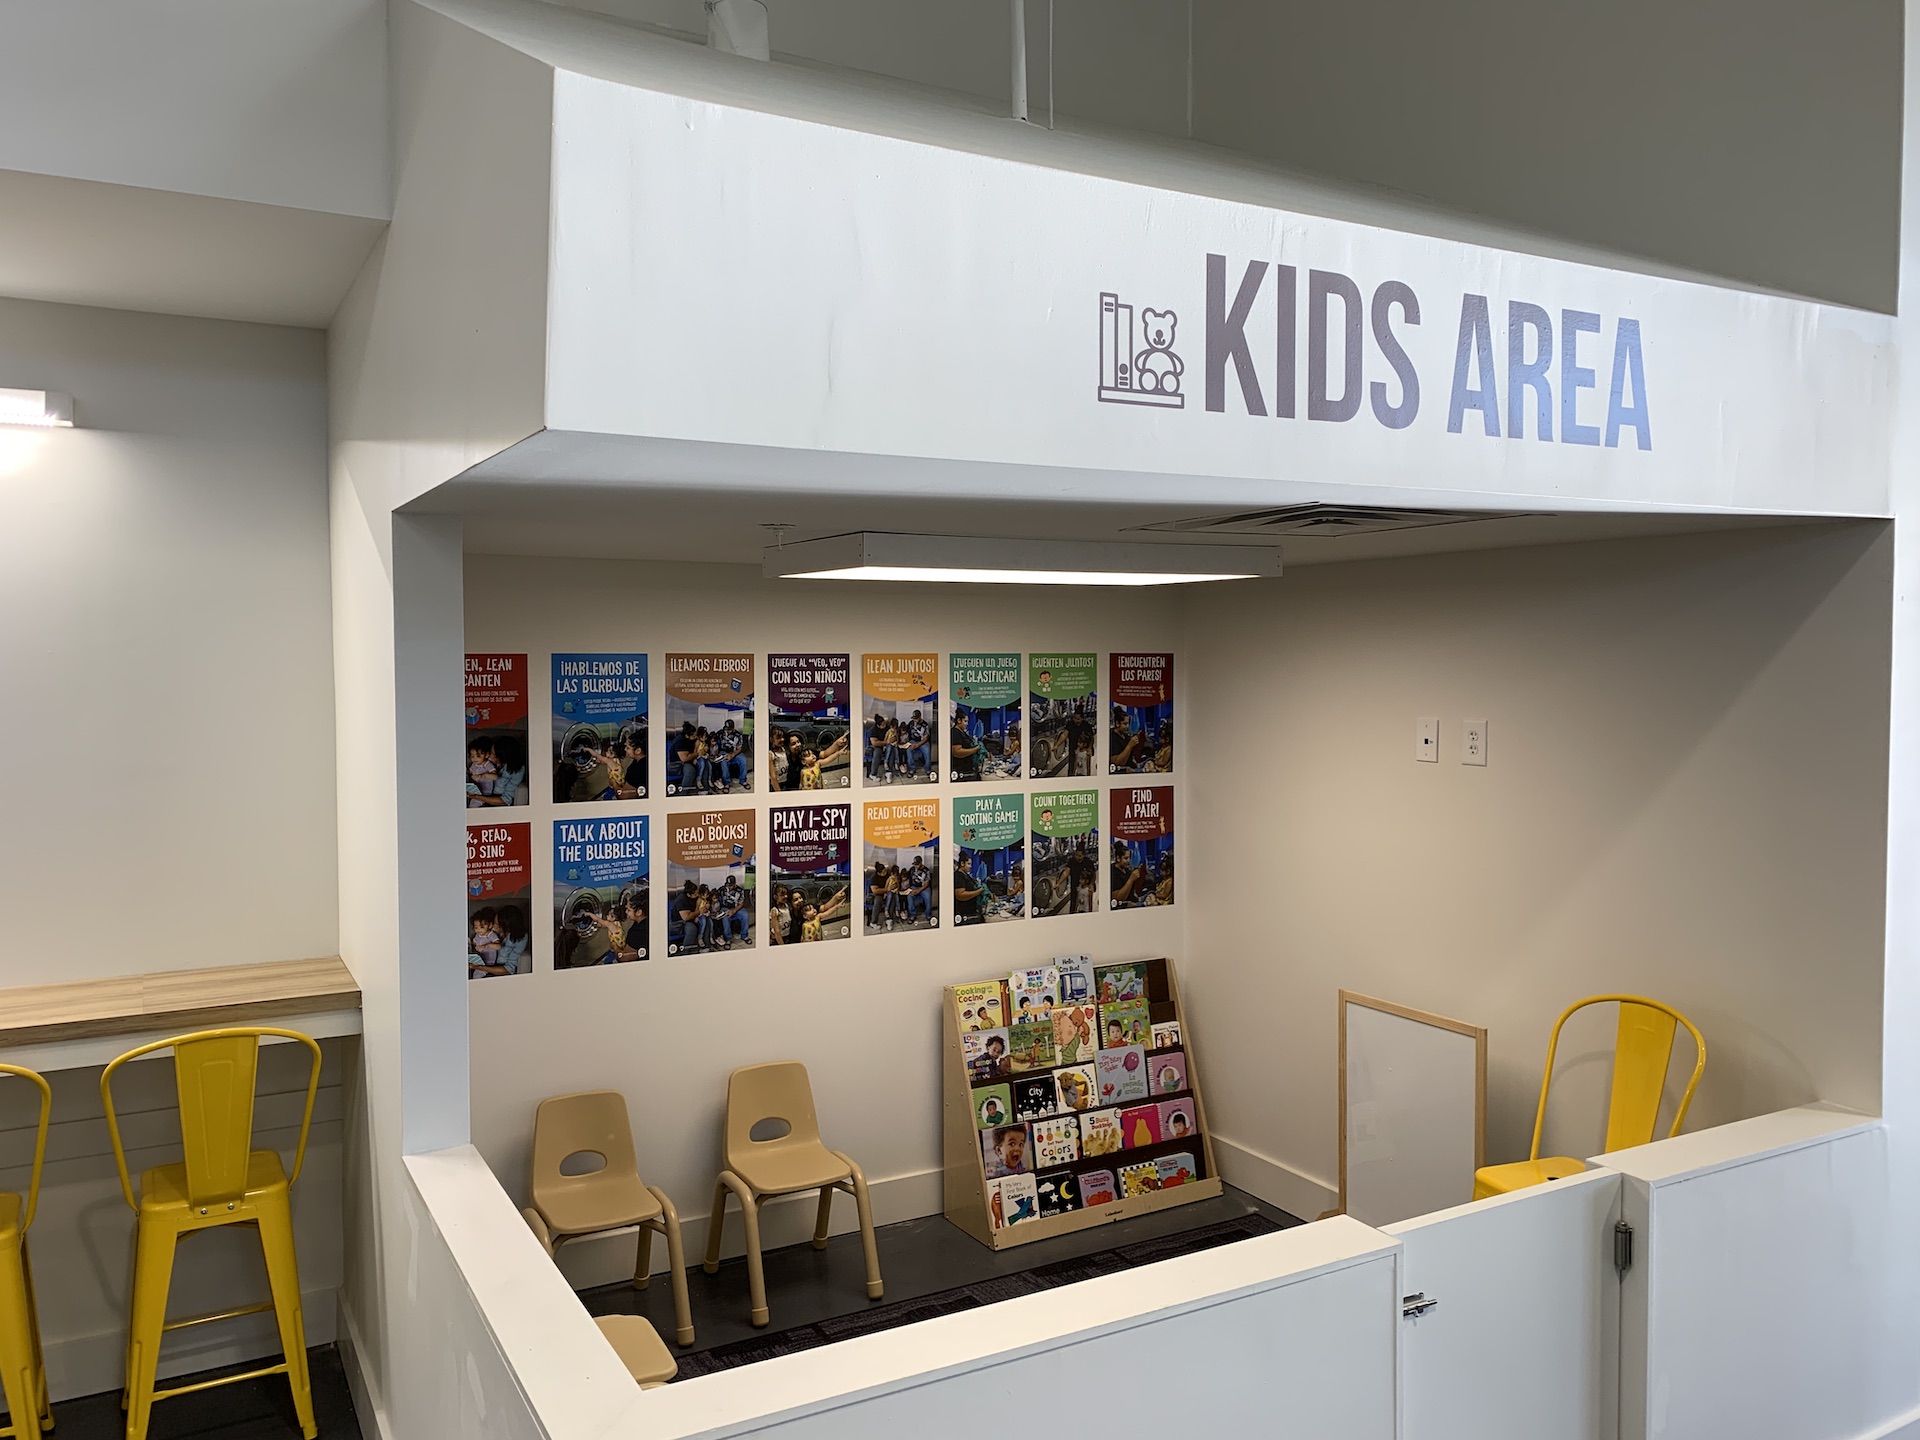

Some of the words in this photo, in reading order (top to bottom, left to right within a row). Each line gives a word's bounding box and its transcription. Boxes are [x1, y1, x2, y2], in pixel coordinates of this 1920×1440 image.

[1205, 252, 1421, 430] KIDS
[1446, 292, 1653, 452] AREA
[486, 658, 512, 671] LEAN
[561, 661, 622, 676] ¡HABLEMOS
[625, 661, 640, 676] DE
[713, 658, 750, 672] LIBROS!
[799, 658, 807, 667] AL
[896, 658, 935, 674] JUNTOS!
[997, 657, 1018, 668] JUEGO
[771, 670, 791, 684] CON
[793, 670, 812, 683] SUS
[814, 668, 846, 683] NIÑOS!
[953, 670, 965, 683] DE
[966, 669, 1017, 683] CLASIFICAR!
[1121, 669, 1135, 681] LOS
[1136, 669, 1162, 681] PARES!
[556, 678, 578, 694] LAS
[582, 678, 644, 693] BURBUJAS!
[1033, 795, 1057, 808] COUNT
[1058, 793, 1096, 806] TOGETHER!
[1132, 789, 1152, 803] FIND
[867, 807, 889, 820] READ
[892, 803, 936, 818] TOGETHER!
[975, 799, 994, 811] PLAY
[995, 798, 1002, 810] A
[1125, 804, 1131, 819] A
[1134, 802, 1160, 818] PAIR!
[701, 813, 723, 825] LET'S
[773, 810, 805, 830] PLAY
[809, 808, 847, 828] I-SPY
[959, 812, 993, 826] SORTING
[995, 810, 1019, 823] GAME!
[481, 828, 512, 843] READ,
[560, 824, 595, 843] TALK
[599, 820, 643, 841] ABOUT
[676, 826, 705, 843] READ
[708, 822, 748, 841] BOOKS!
[774, 831, 796, 843] WITH
[798, 829, 819, 842] YOUR
[821, 827, 848, 840] CHILD!
[479, 844, 505, 859] SING
[558, 845, 582, 862] THE
[586, 840, 645, 861] BUBBLES!
[955, 986, 986, 996] Cooking
[1028, 1088, 1044, 1096] City
[1089, 1117, 1095, 1125] 5
[1096, 1116, 1109, 1124] Busy
[1041, 1145, 1071, 1157] Colors
[1041, 1208, 1061, 1217] Home
